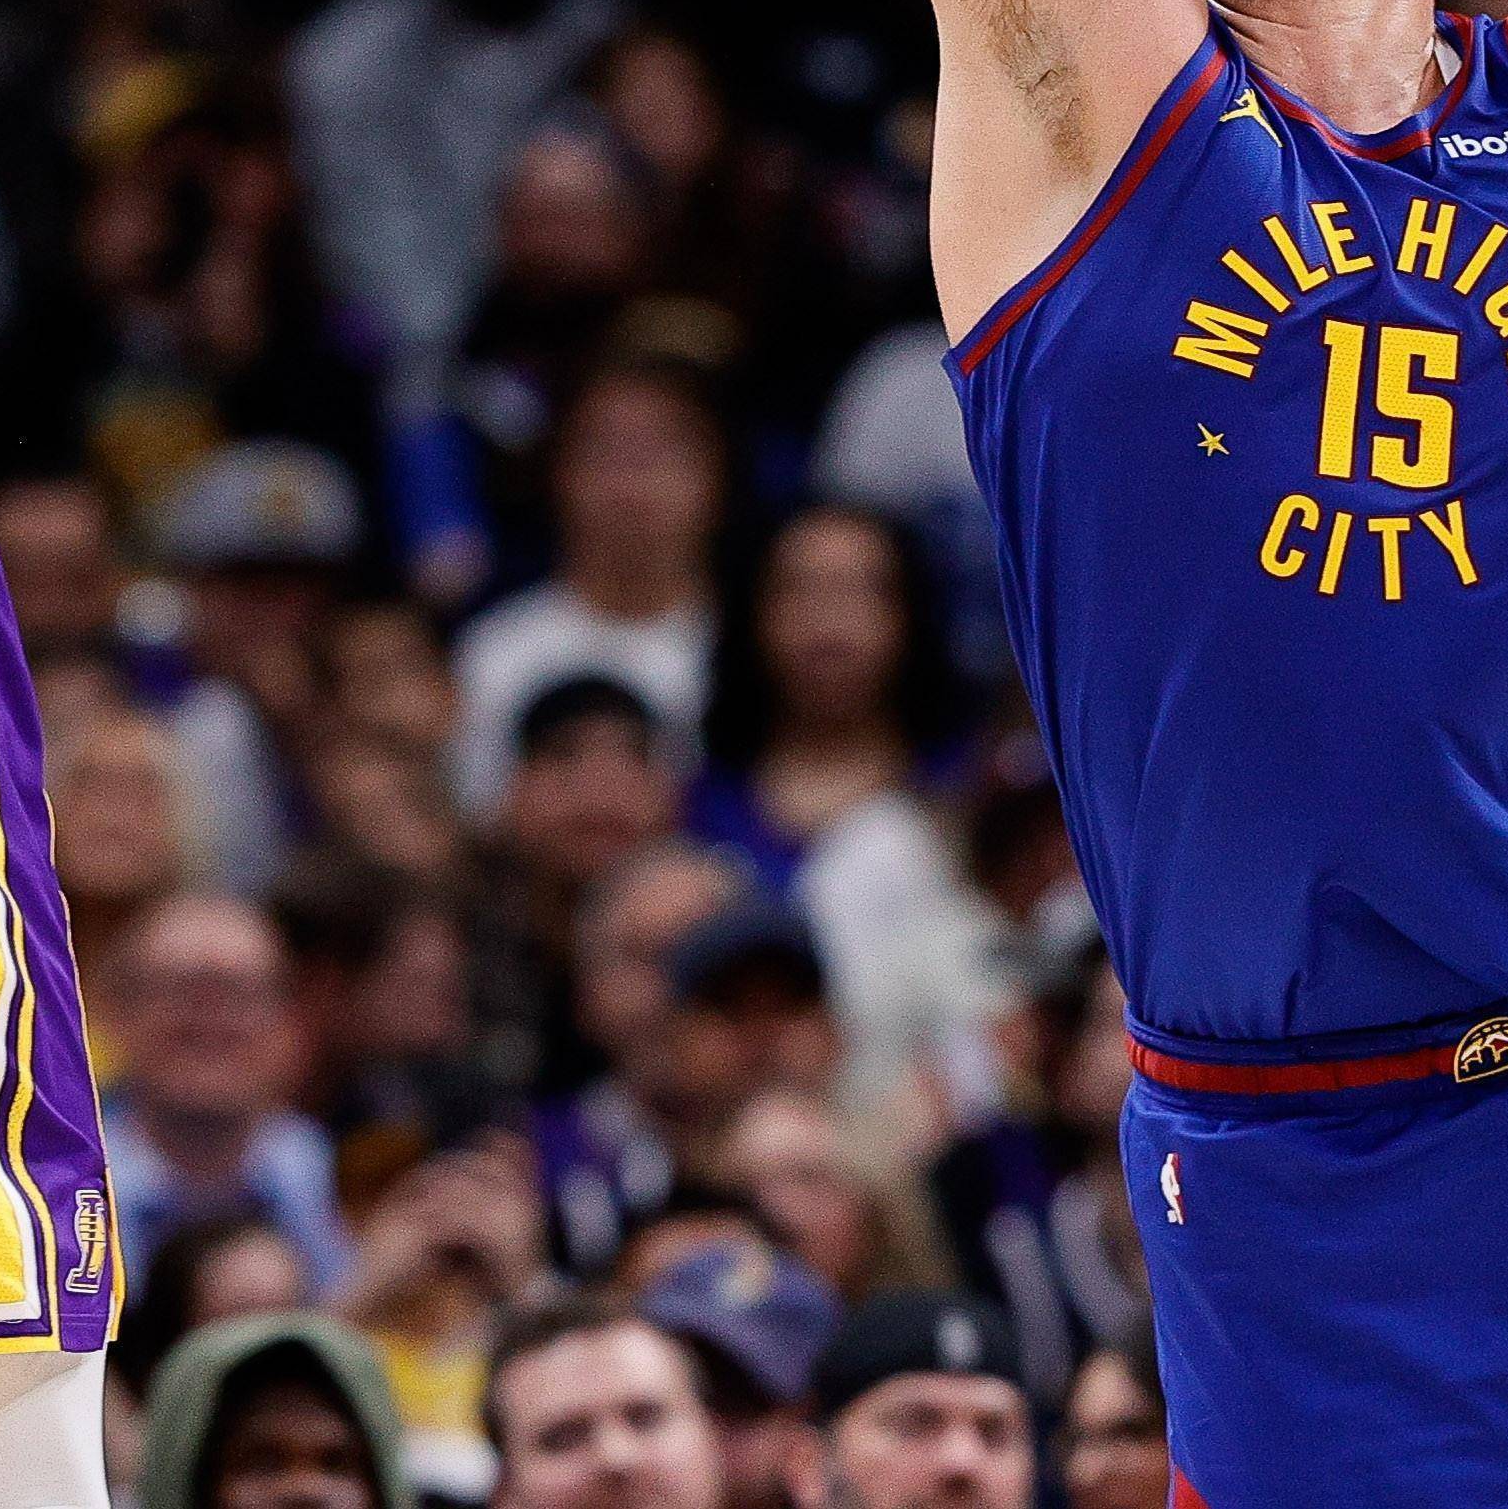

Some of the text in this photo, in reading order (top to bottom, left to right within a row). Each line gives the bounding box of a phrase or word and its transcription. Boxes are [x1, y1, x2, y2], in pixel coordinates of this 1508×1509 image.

[1171, 200, 1375, 380] MILE
[1317, 315, 1460, 490] 15
[1258, 493, 1480, 602] CITY
